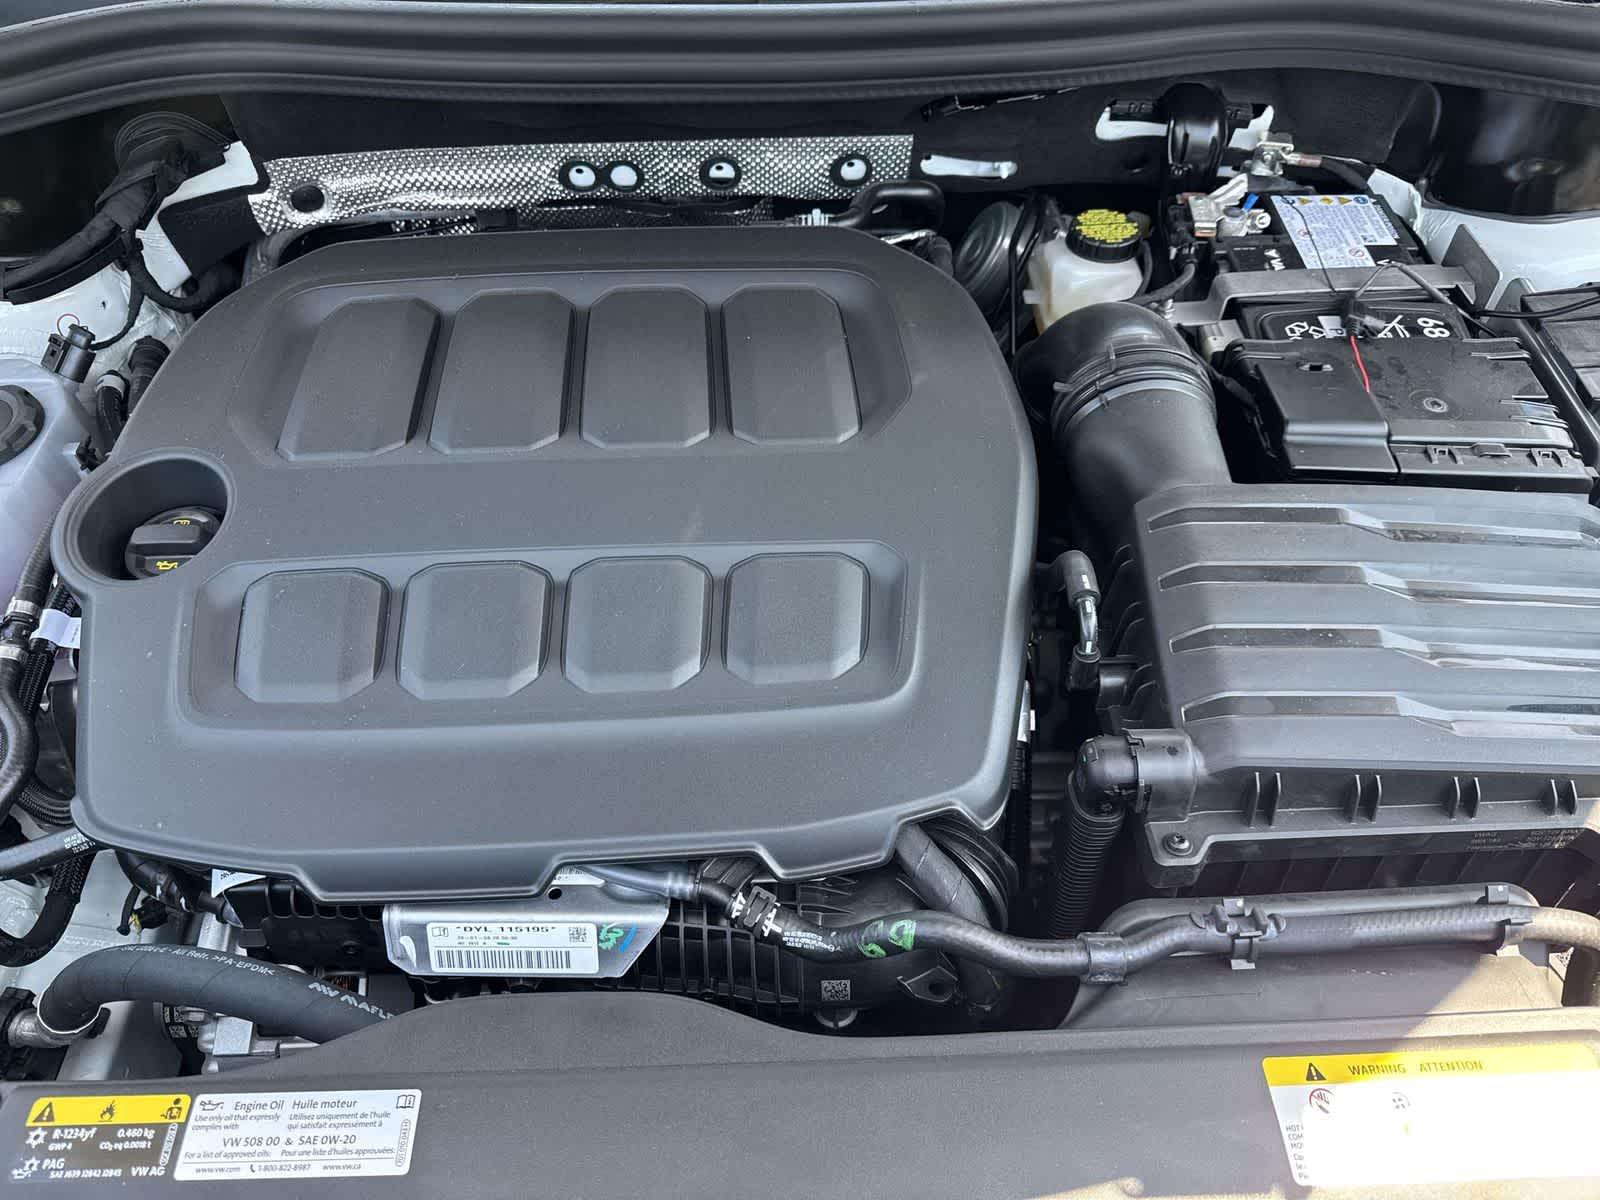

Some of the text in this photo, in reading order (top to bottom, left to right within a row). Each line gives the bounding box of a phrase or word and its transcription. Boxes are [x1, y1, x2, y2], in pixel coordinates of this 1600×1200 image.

[1348, 1060, 1484, 1076] WARNING ATTENTION
[234, 1100, 285, 1113] Engine Oil
[292, 1100, 358, 1110] Huile moteur
[248, 1113, 280, 1122] expressly
[316, 1113, 359, 1121] uniquement
[52, 1127, 97, 1142] R-1234yf
[143, 1127, 156, 1139] kg
[223, 1134, 357, 1147] VW 508 00 & SAE 0W-20
[42, 1158, 65, 1170] PAG
[131, 1165, 167, 1177] VW AG
